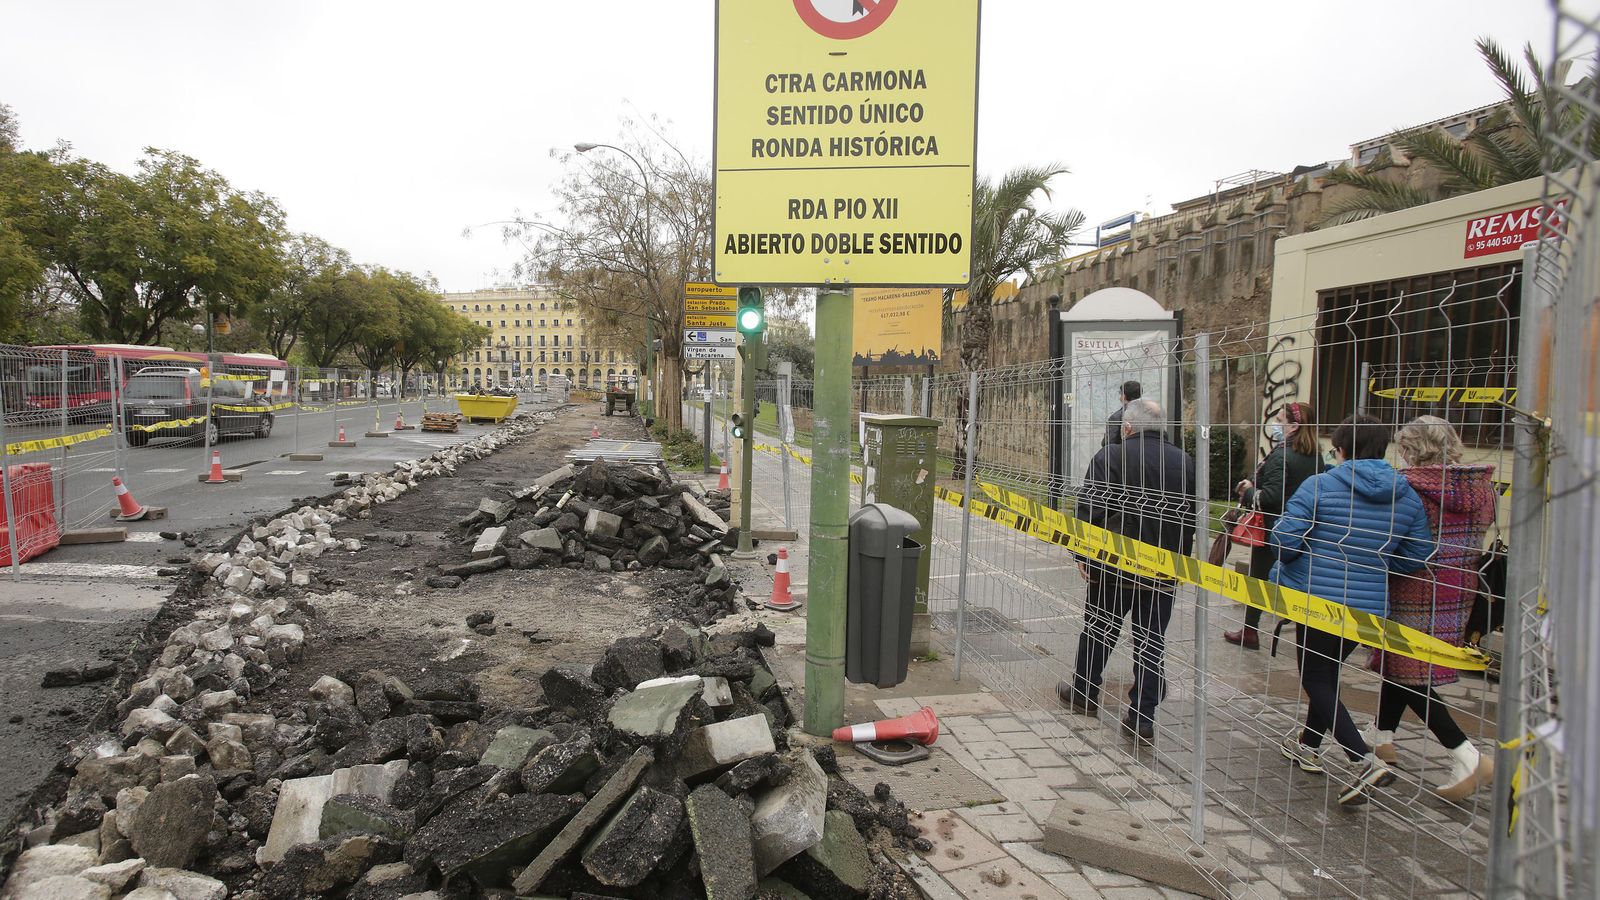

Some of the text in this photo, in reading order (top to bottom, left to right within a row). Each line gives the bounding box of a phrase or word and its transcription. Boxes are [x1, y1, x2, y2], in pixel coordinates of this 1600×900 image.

[765, 69, 927, 93] CTRA CARMONA
[766, 98, 924, 125] SENTIDO ÚNICO
[751, 130, 939, 158] RONDA HISTÓRICA
[788, 198, 898, 220] RDA PIO XII
[724, 232, 962, 254] ABIERTO DOBLE SENTIDO
[1475, 233, 1523, 250] 95 440 50 21
[1077, 339, 1121, 349] SEVILLA
